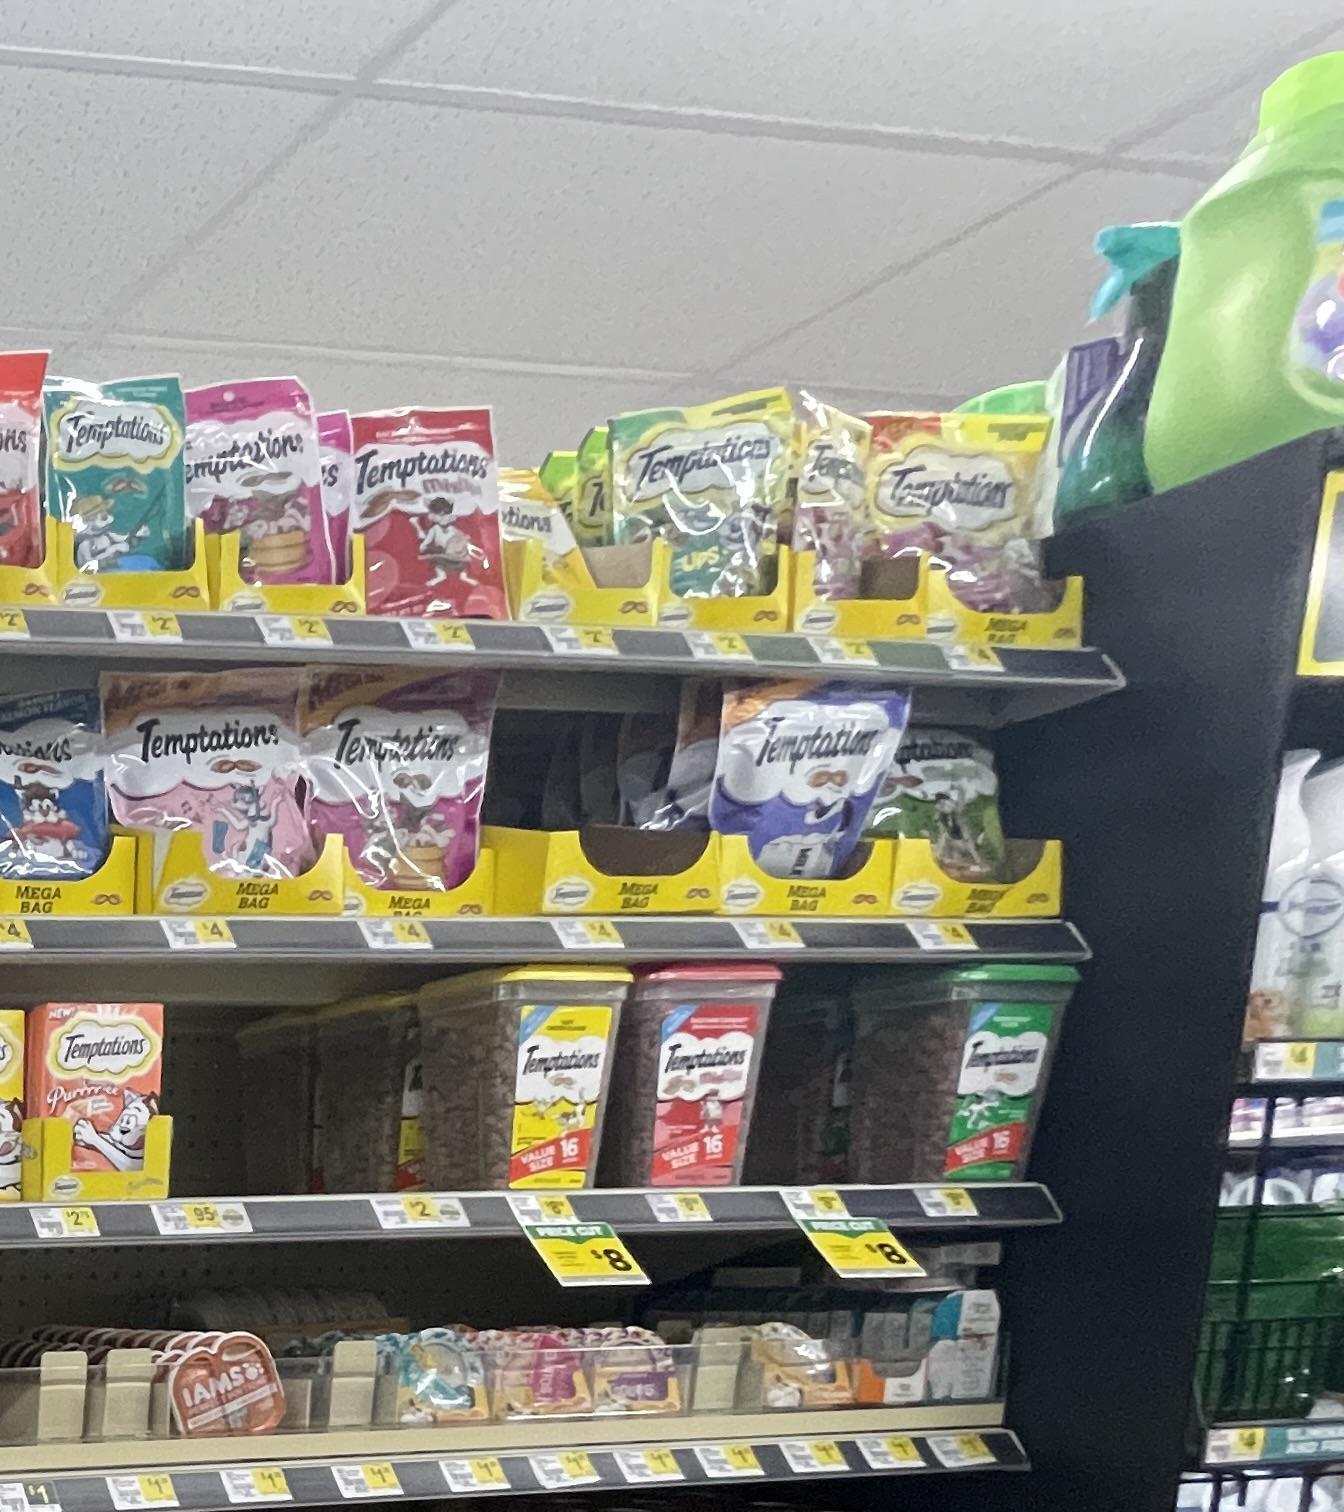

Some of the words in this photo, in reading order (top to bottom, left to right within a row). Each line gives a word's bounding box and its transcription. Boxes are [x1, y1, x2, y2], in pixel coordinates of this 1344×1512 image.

[357, 449, 489, 493] Temptations
[639, 437, 771, 483] Temptations
[138, 719, 279, 764] Temptations
[757, 719, 877, 767] Temptations
[16, 885, 61, 901] MEGA
[236, 883, 279, 896] MEGA
[21, 901, 53, 914] BAG
[239, 896, 270, 910] BAG
[64, 1035, 145, 1069] Temptations
[523, 1046, 600, 1078] Temptations
[664, 1044, 744, 1071] Temptations
[521, 1148, 555, 1164] VALUE
[662, 1144, 699, 1161] VALUE
[538, 1226, 568, 1236] PRICE
[576, 1226, 601, 1236] CUT
[811, 1221, 840, 1231] PRICE
[850, 1220, 874, 1231] CUT
[182, 1368, 244, 1407] IAMS
